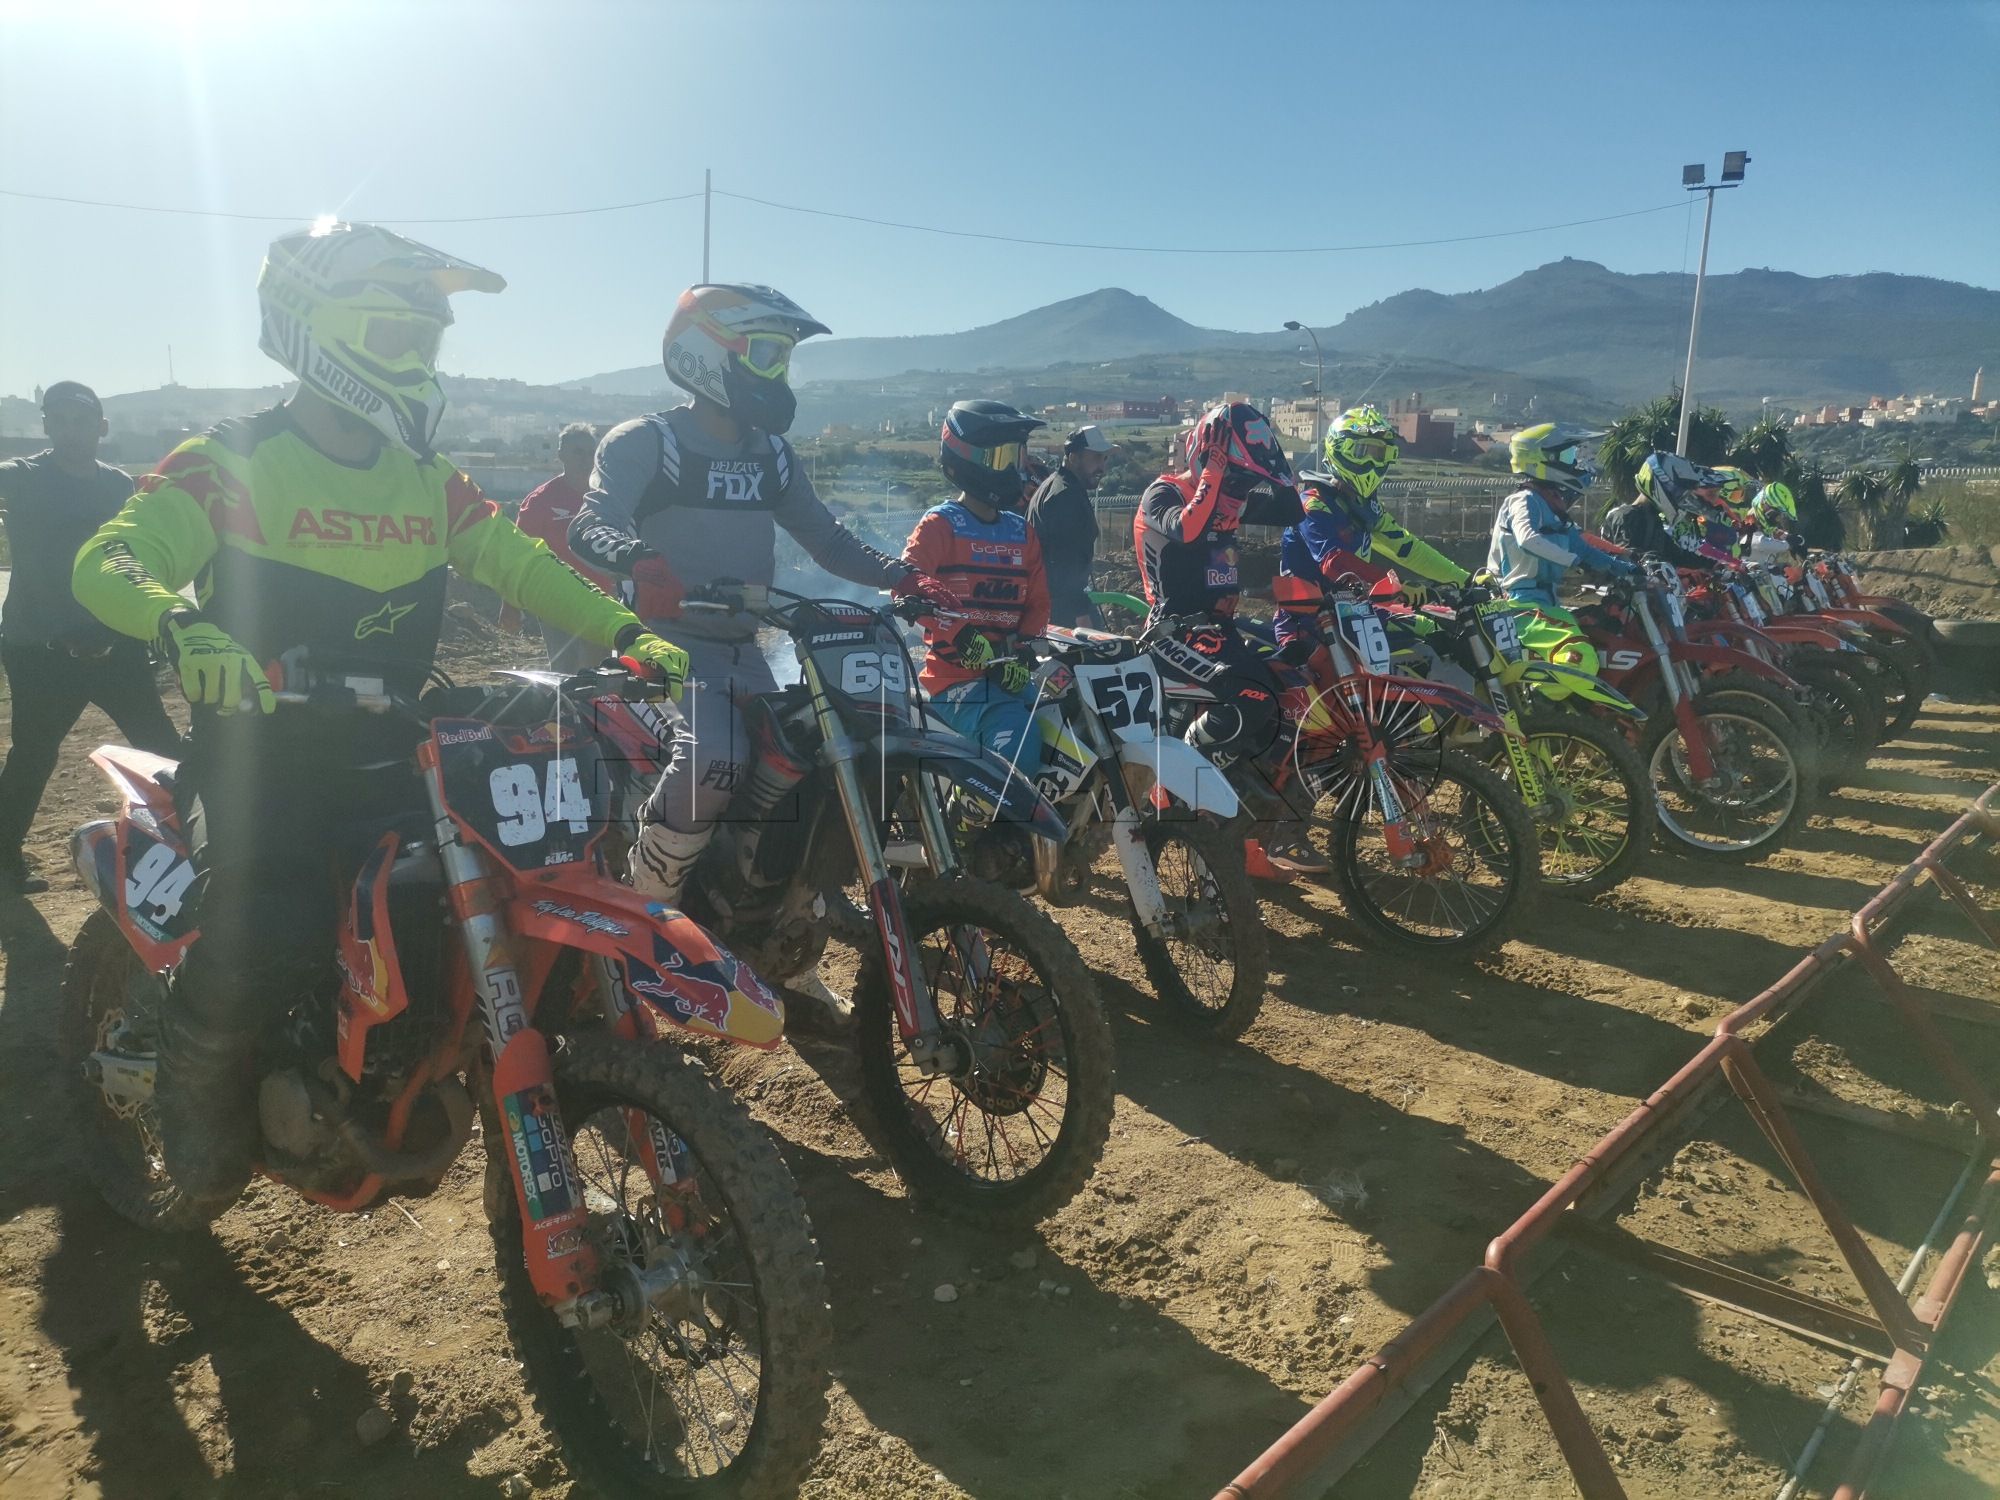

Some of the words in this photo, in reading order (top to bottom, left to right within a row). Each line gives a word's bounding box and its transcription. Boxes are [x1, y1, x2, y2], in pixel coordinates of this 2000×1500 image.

[706, 471, 765, 501] FOX
[710, 460, 761, 472] DELICATE
[840, 650, 908, 695] 69
[1237, 688, 1270, 702] FOX
[1091, 671, 1155, 730] 52
[965, 777, 1013, 807] DUNLOP
[1508, 735, 1538, 803] DUNLOP
[489, 757, 592, 847] 94
[124, 842, 198, 926] 94
[544, 850, 575, 866] KTM
[511, 1131, 539, 1202] MOTOREX
[536, 1111, 564, 1189] GoPro
